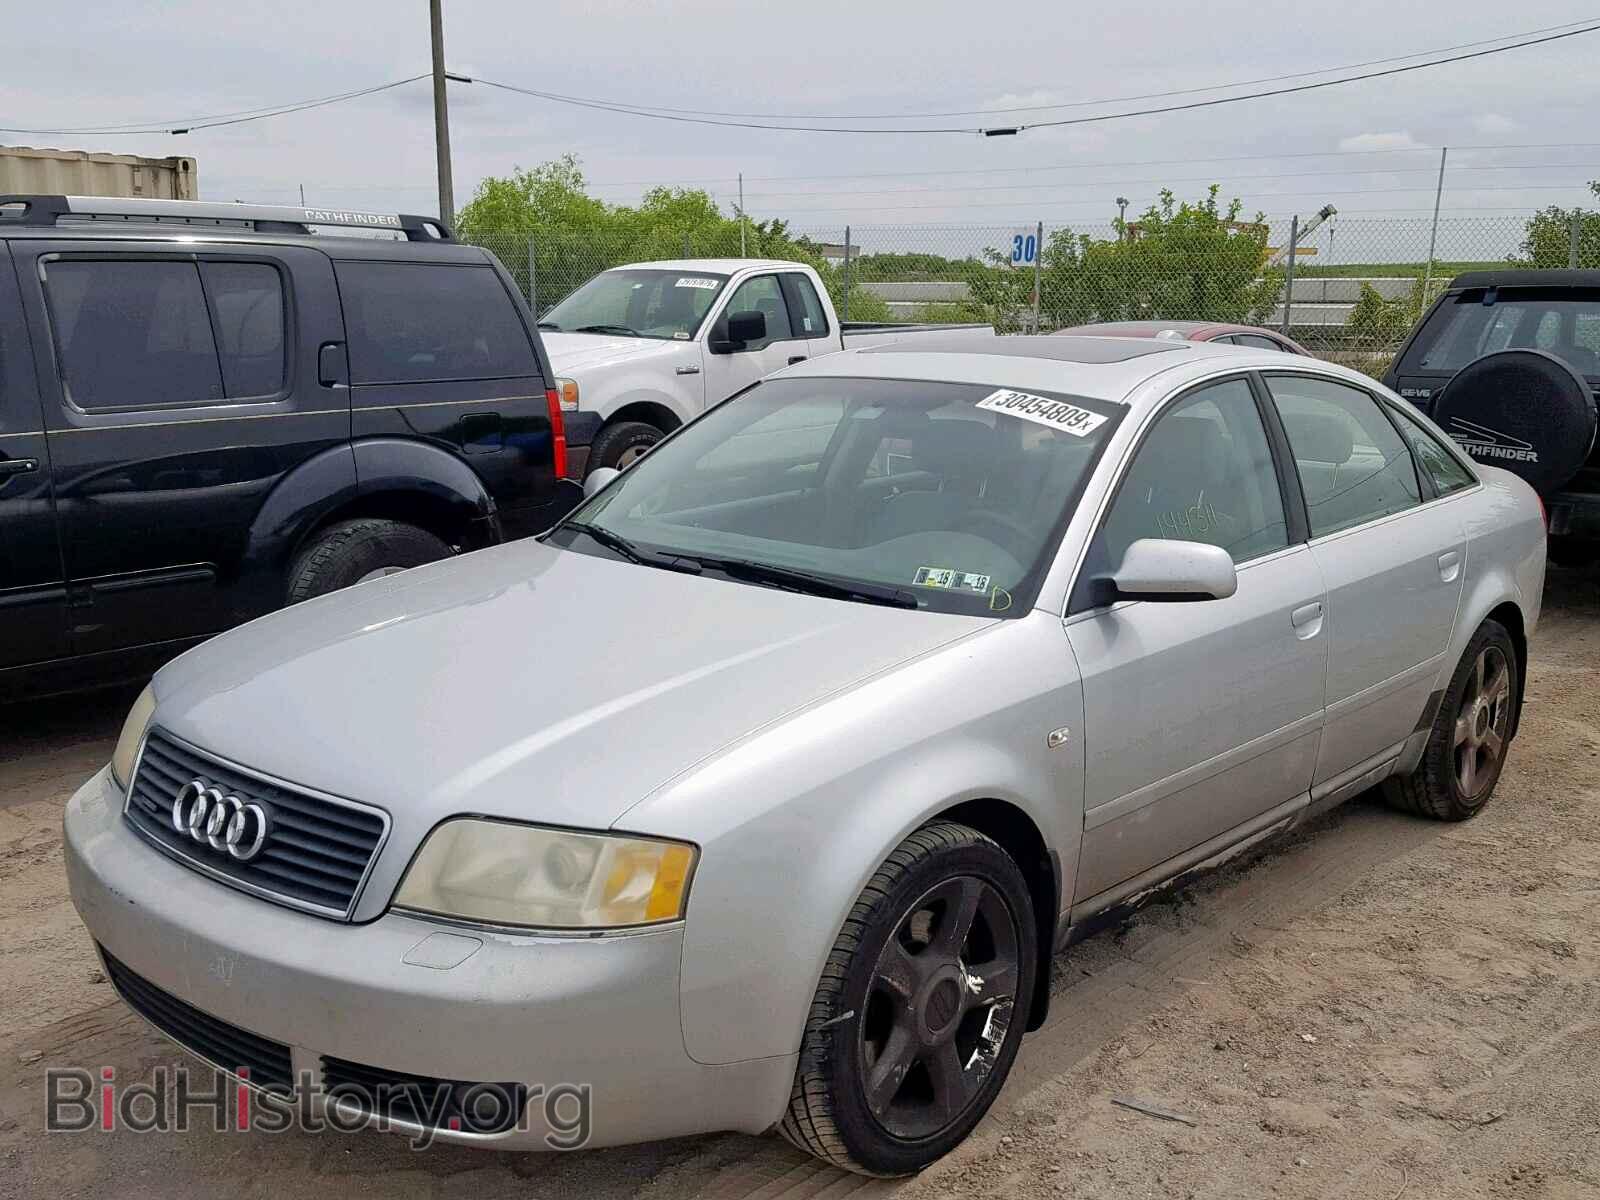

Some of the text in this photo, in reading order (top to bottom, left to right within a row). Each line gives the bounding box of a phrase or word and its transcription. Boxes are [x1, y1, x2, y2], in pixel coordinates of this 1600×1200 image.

[304, 208, 399, 226] PATHFINDER
[1012, 234, 1035, 262] 30
[995, 392, 1091, 427] 30454809
